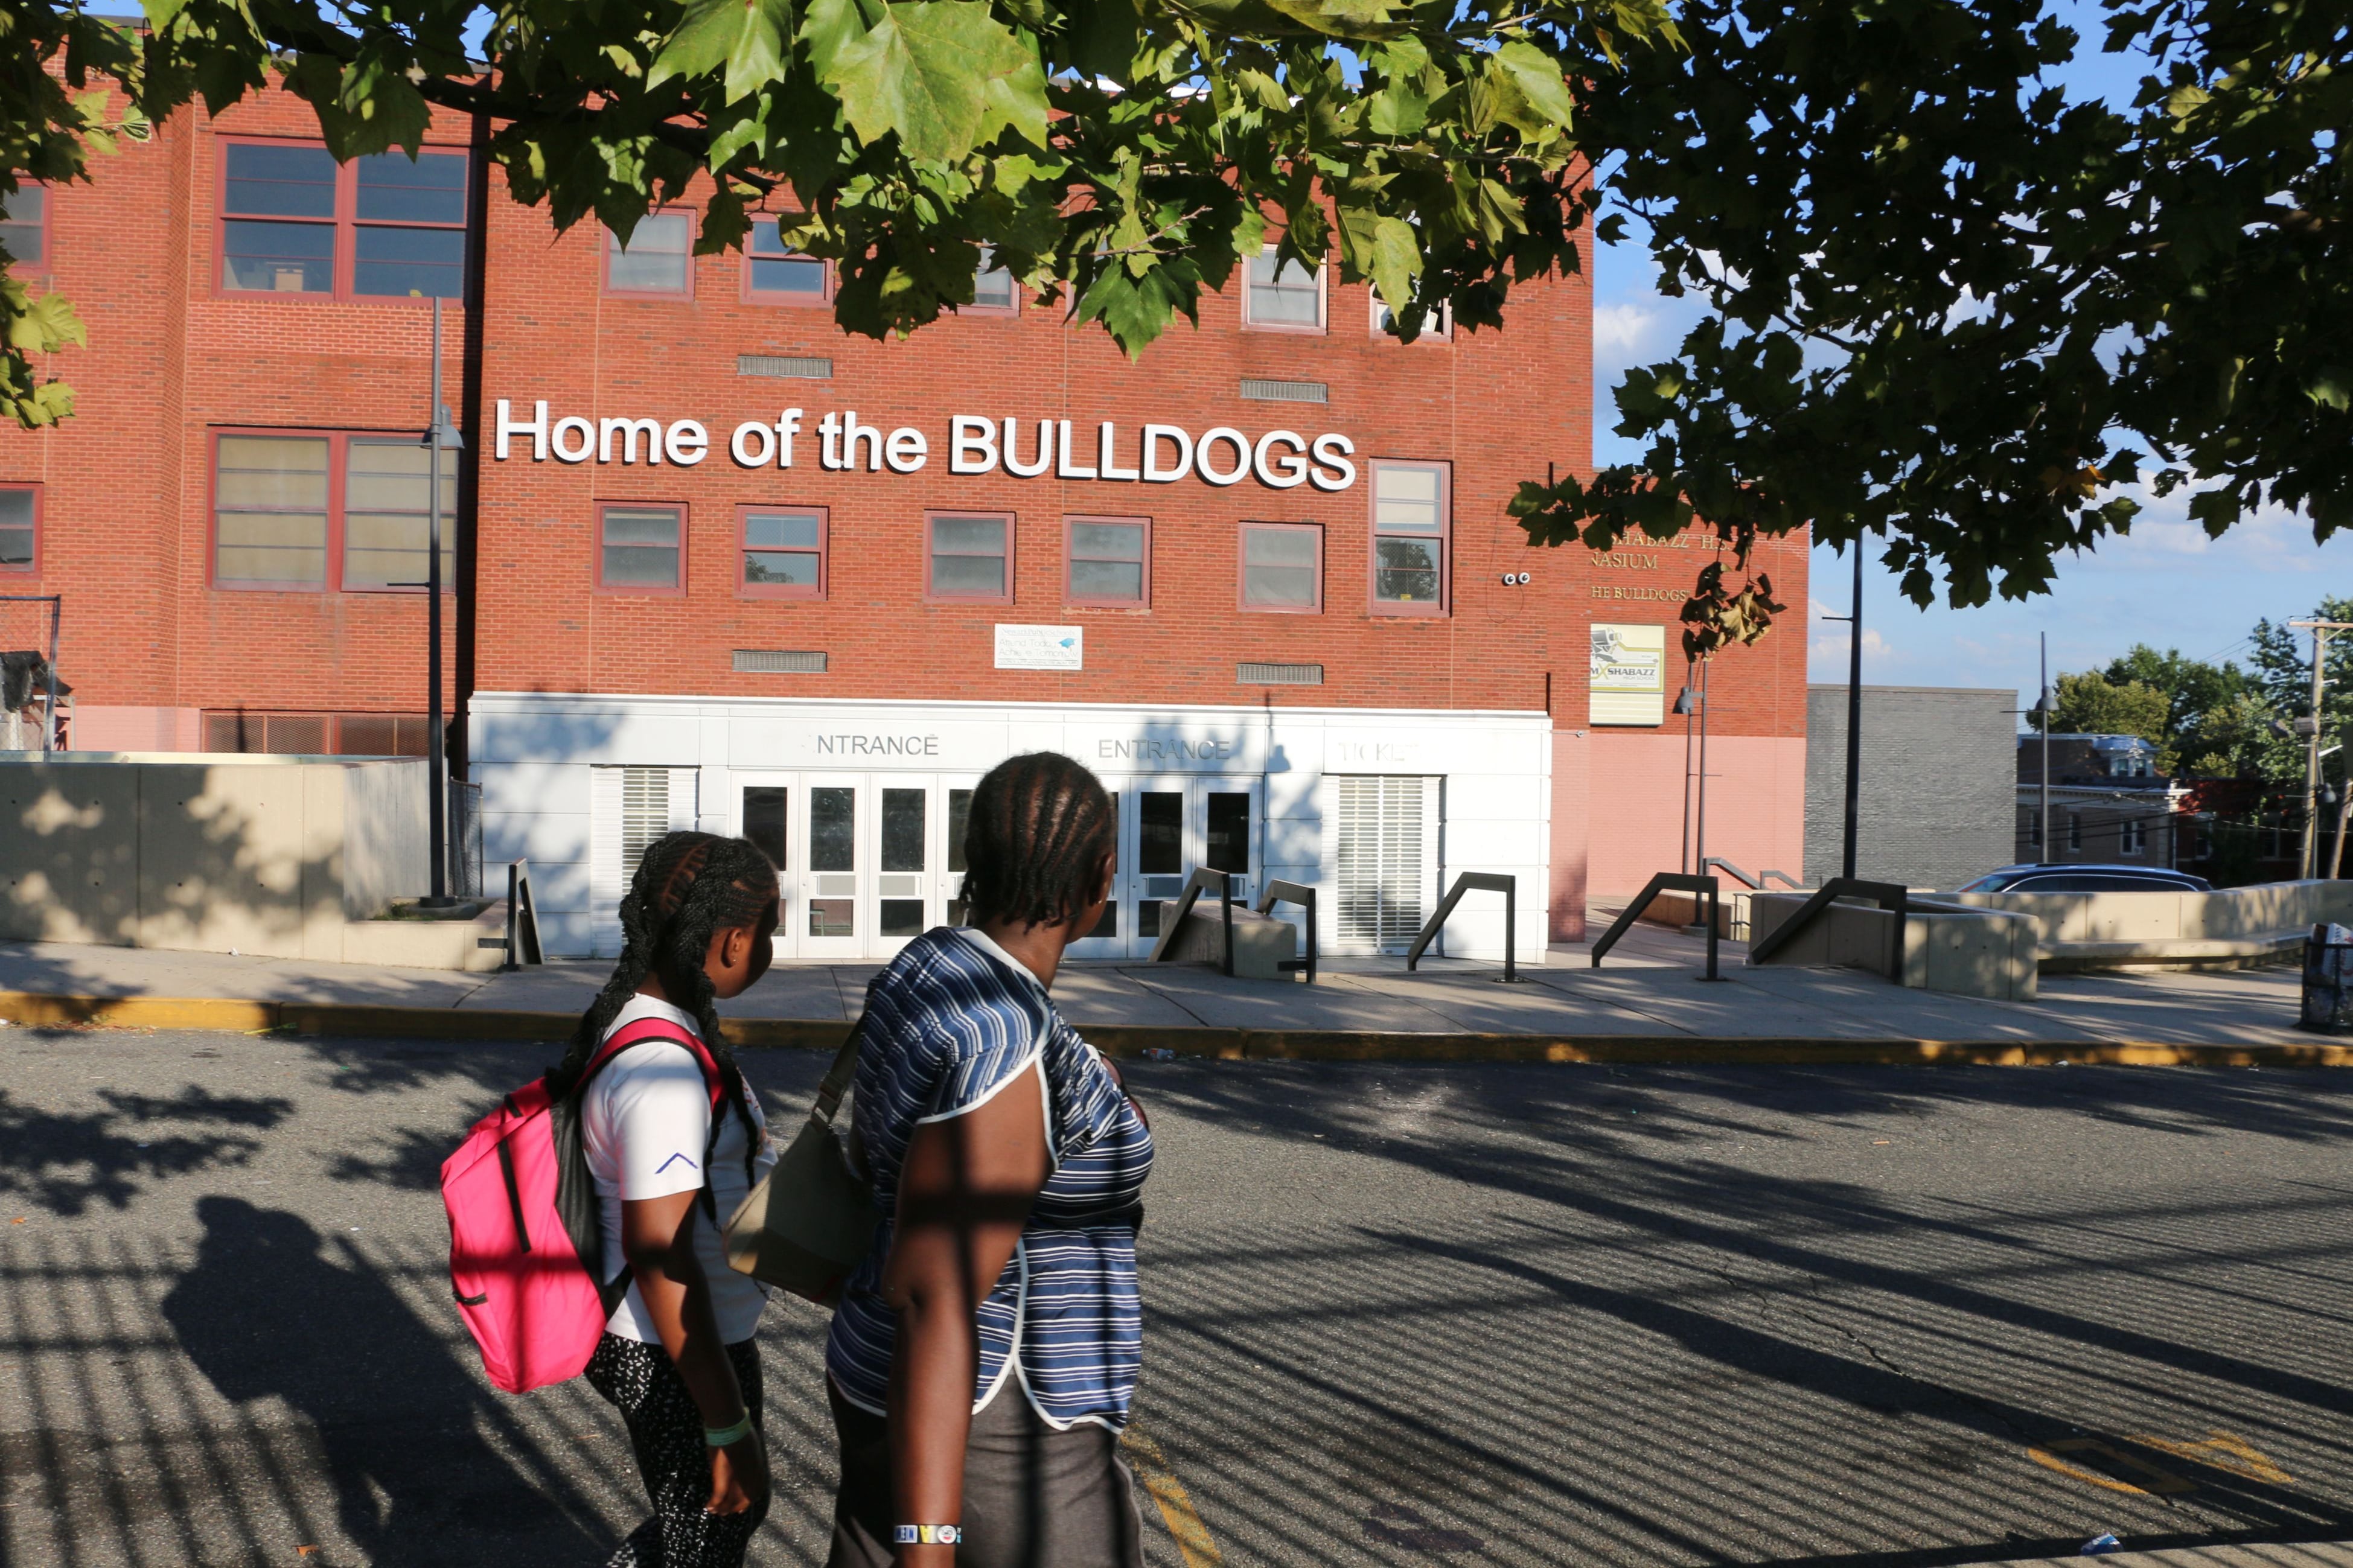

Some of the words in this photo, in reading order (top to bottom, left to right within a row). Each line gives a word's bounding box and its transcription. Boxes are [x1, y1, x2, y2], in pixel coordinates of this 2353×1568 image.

[496, 400, 708, 465] Home
[732, 408, 803, 467] of
[819, 410, 927, 472] the
[951, 415, 1356, 490] BULLDOGS
[1608, 668, 1655, 676] SHABAZZ
[817, 735, 939, 755] NTRANCE
[1099, 739, 1230, 759] ENTRANCE
